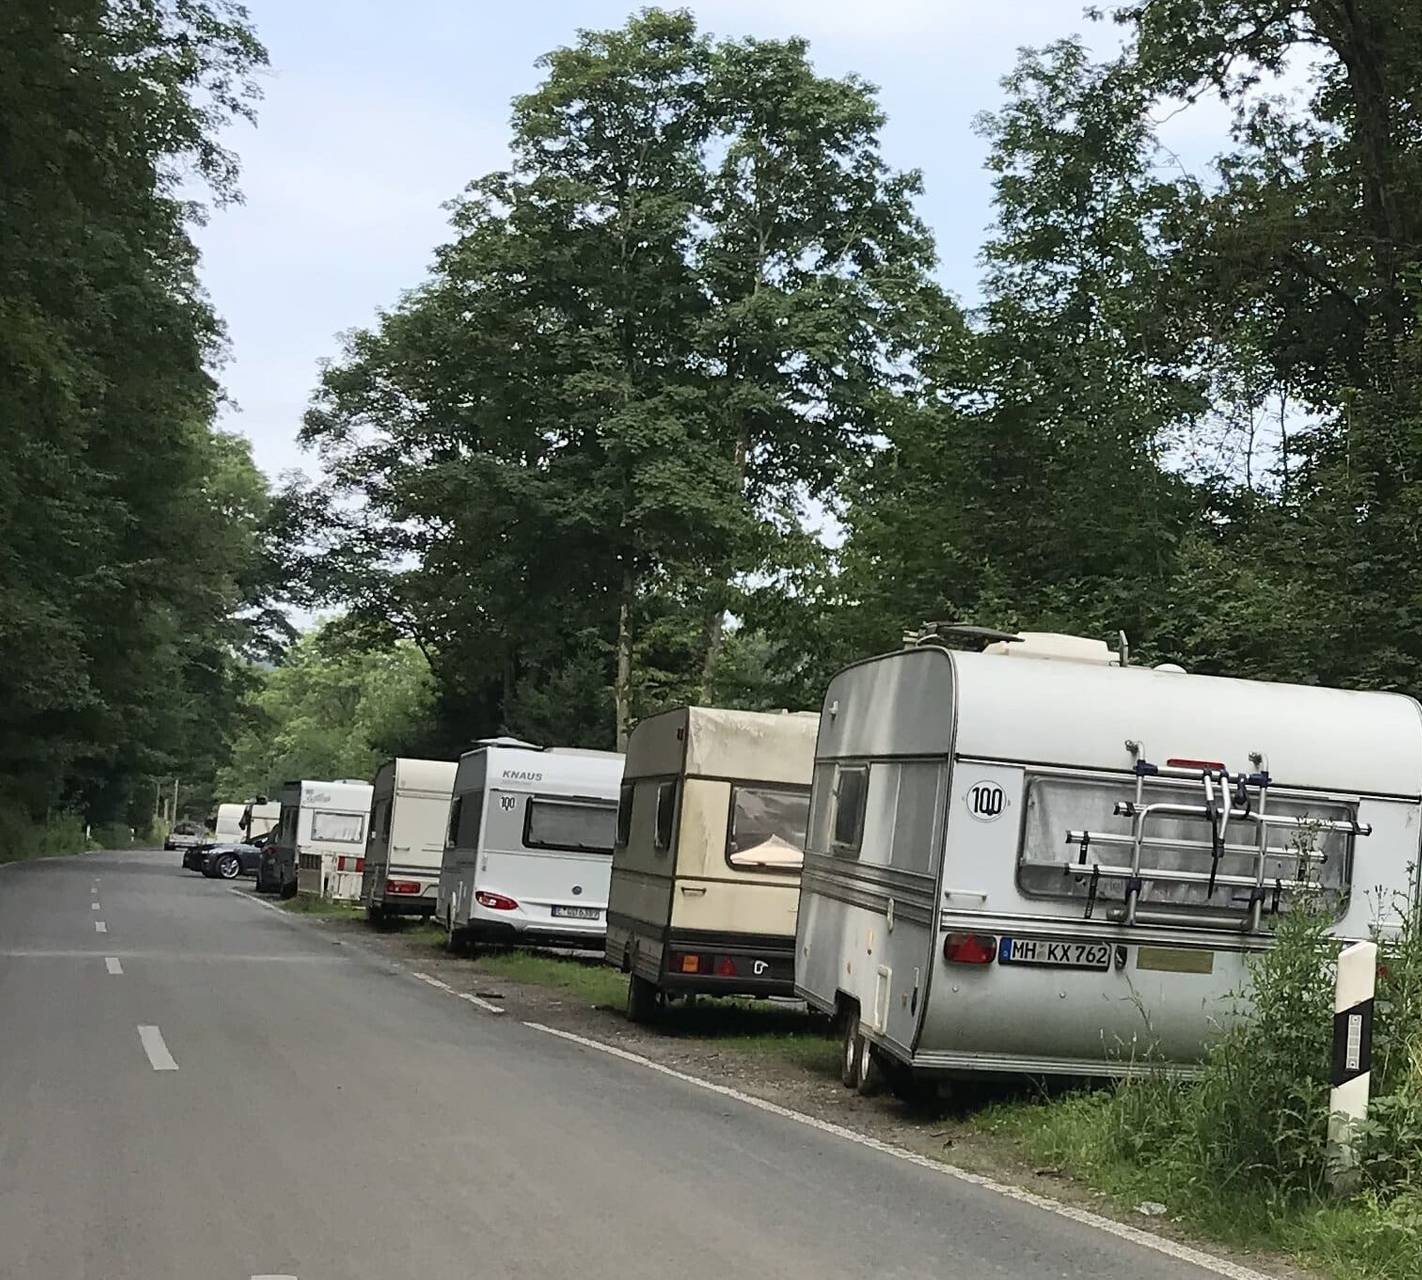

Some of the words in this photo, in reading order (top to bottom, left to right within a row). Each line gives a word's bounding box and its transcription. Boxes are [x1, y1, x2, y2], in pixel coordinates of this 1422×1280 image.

[502, 770, 543, 782] KNAUS
[501, 796, 515, 809] 100
[972, 787, 1003, 815] 100
[1012, 941, 1037, 959] MH
[1047, 943, 1071, 962] KX
[1075, 945, 1108, 964] 762
